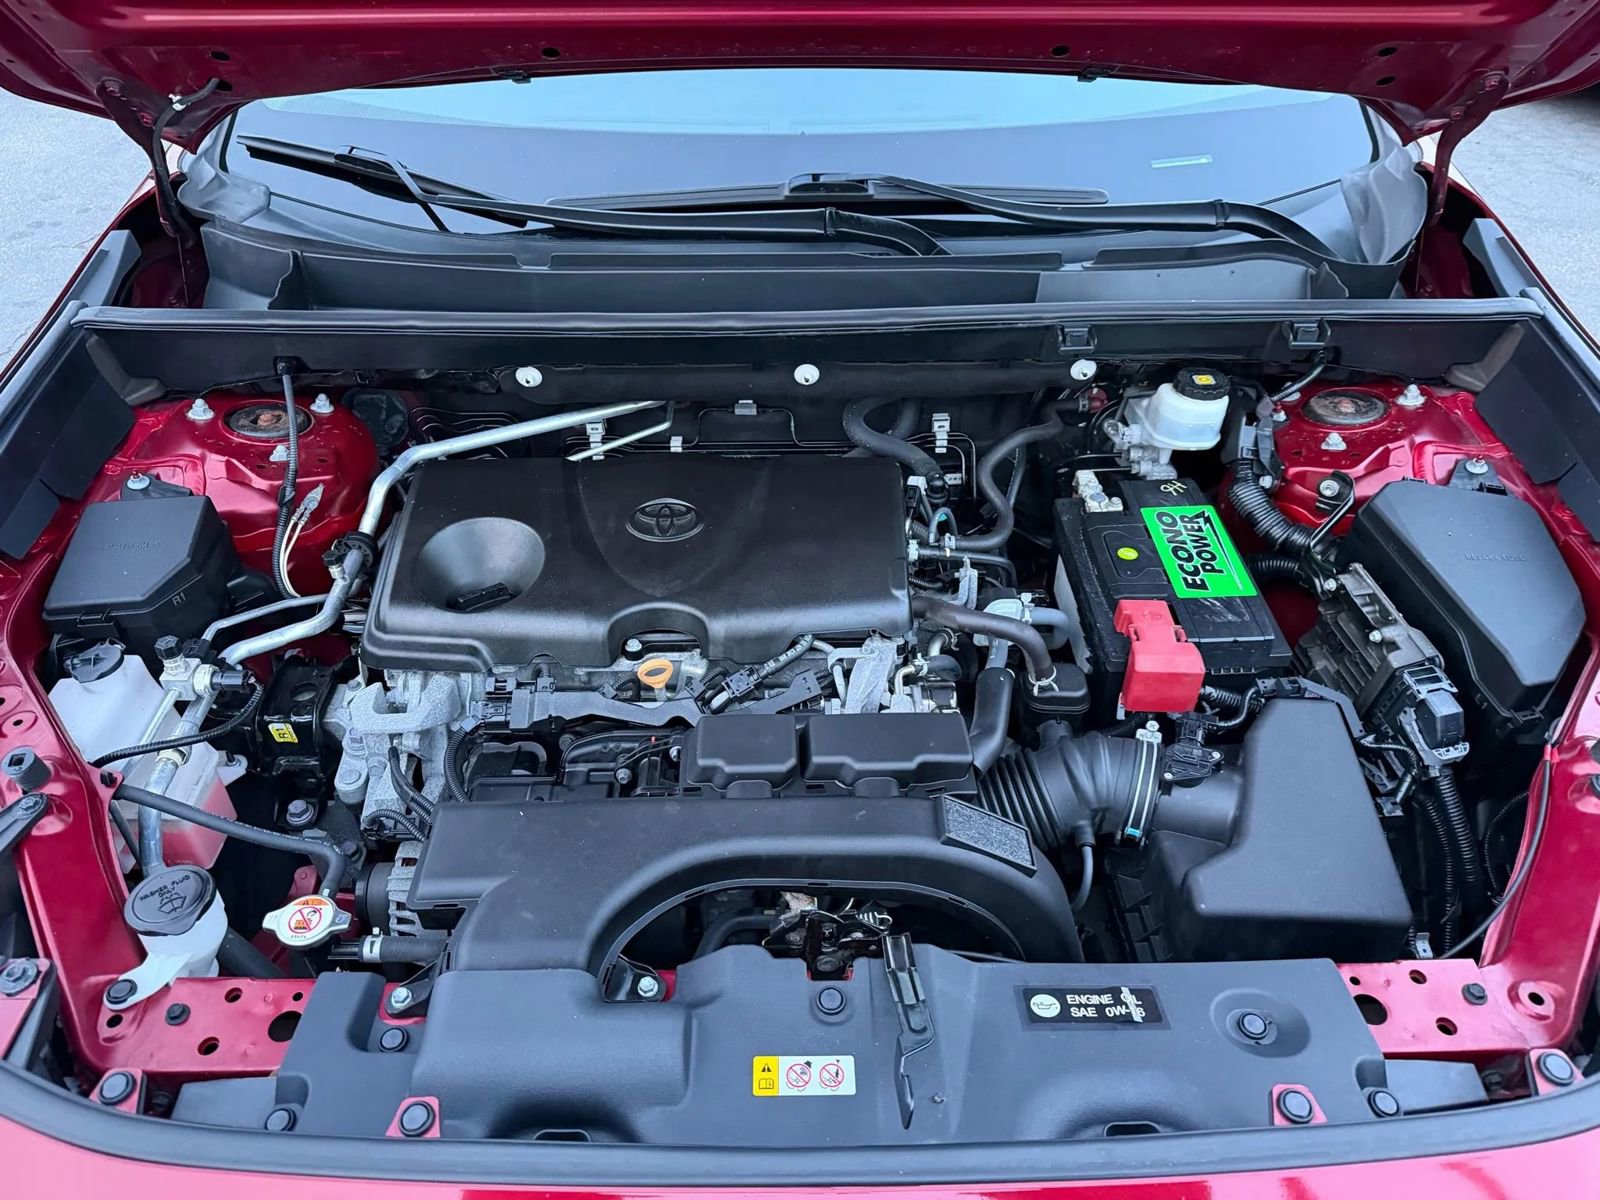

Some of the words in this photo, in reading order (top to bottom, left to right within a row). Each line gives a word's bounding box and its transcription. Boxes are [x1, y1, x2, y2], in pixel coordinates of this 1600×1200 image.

[1178, 509, 1224, 574] POWER
[1155, 511, 1210, 591] ECONO
[172, 592, 186, 606] R1
[171, 875, 190, 886] FLUID
[1066, 994, 1114, 1005] ENGINE
[1070, 1007, 1098, 1018] SAE
